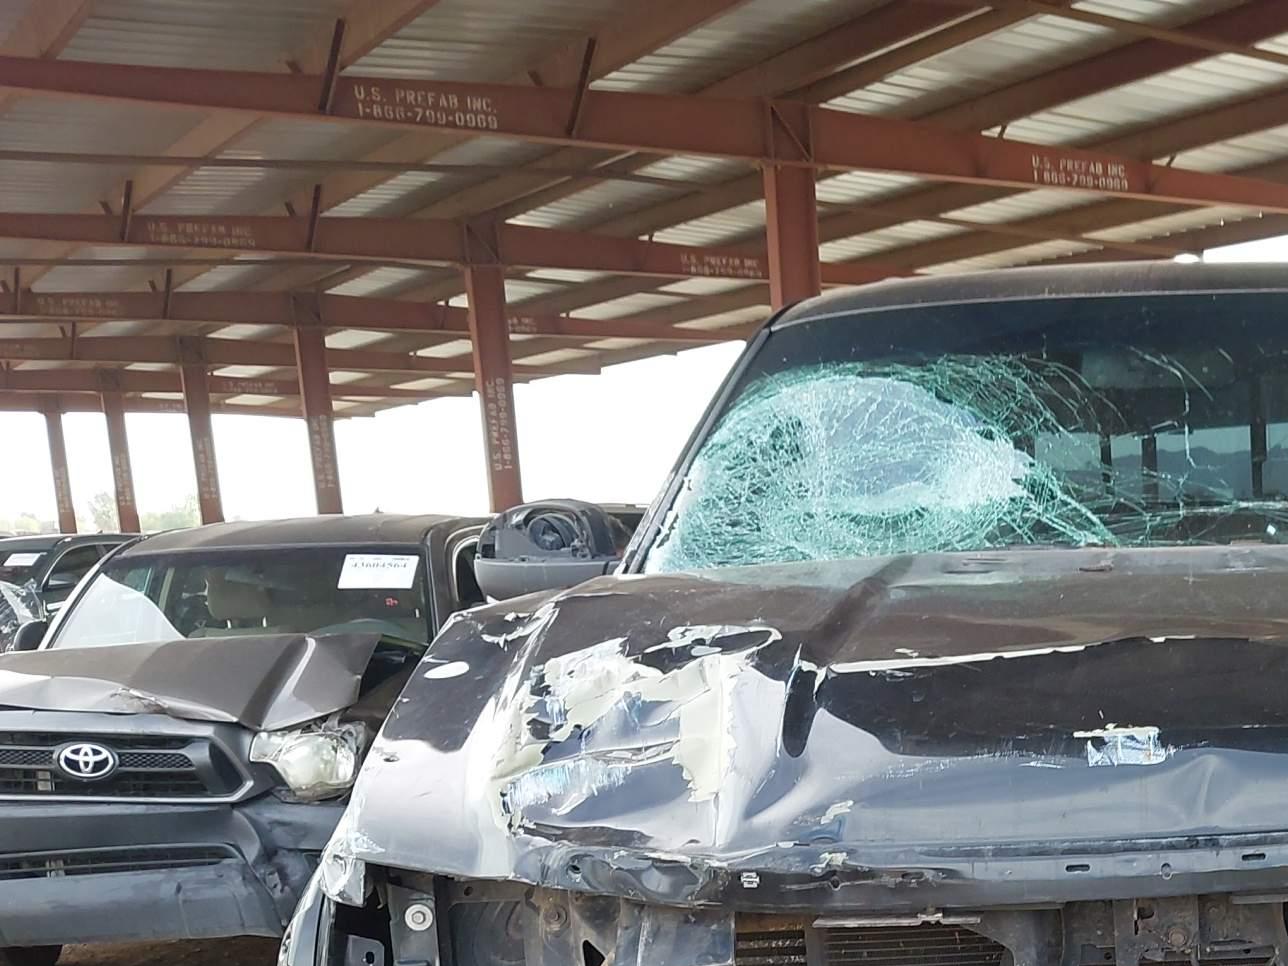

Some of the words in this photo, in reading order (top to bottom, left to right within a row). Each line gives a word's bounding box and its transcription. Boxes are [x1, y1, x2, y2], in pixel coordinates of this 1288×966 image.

[354, 85, 386, 102] U.S.
[395, 88, 458, 109] PREFAB
[466, 95, 497, 114] INC.
[358, 103, 498, 129] 1-866-799-0969
